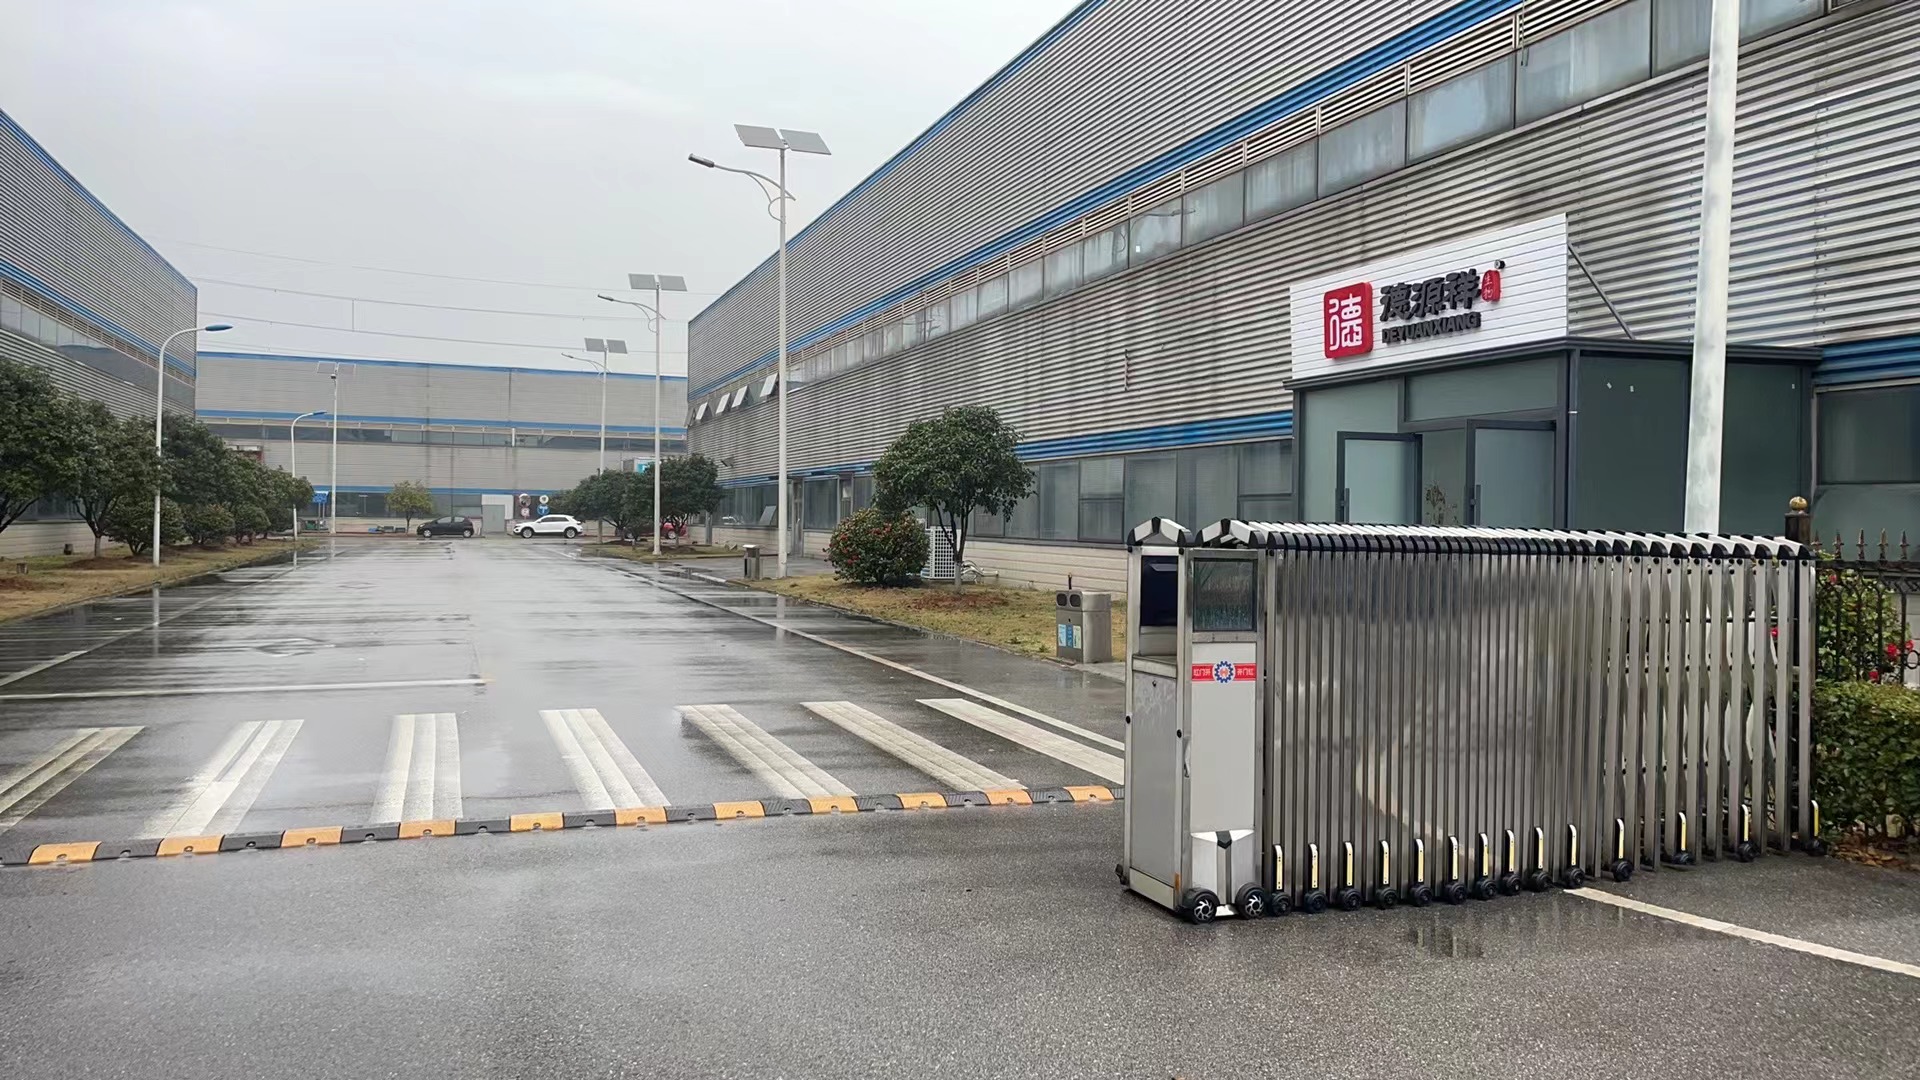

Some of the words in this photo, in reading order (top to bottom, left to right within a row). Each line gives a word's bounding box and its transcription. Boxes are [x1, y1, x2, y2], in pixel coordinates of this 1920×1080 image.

[1380, 268, 1481, 321] 德源祥
[1381, 312, 1482, 344] DEYUANXIANG
